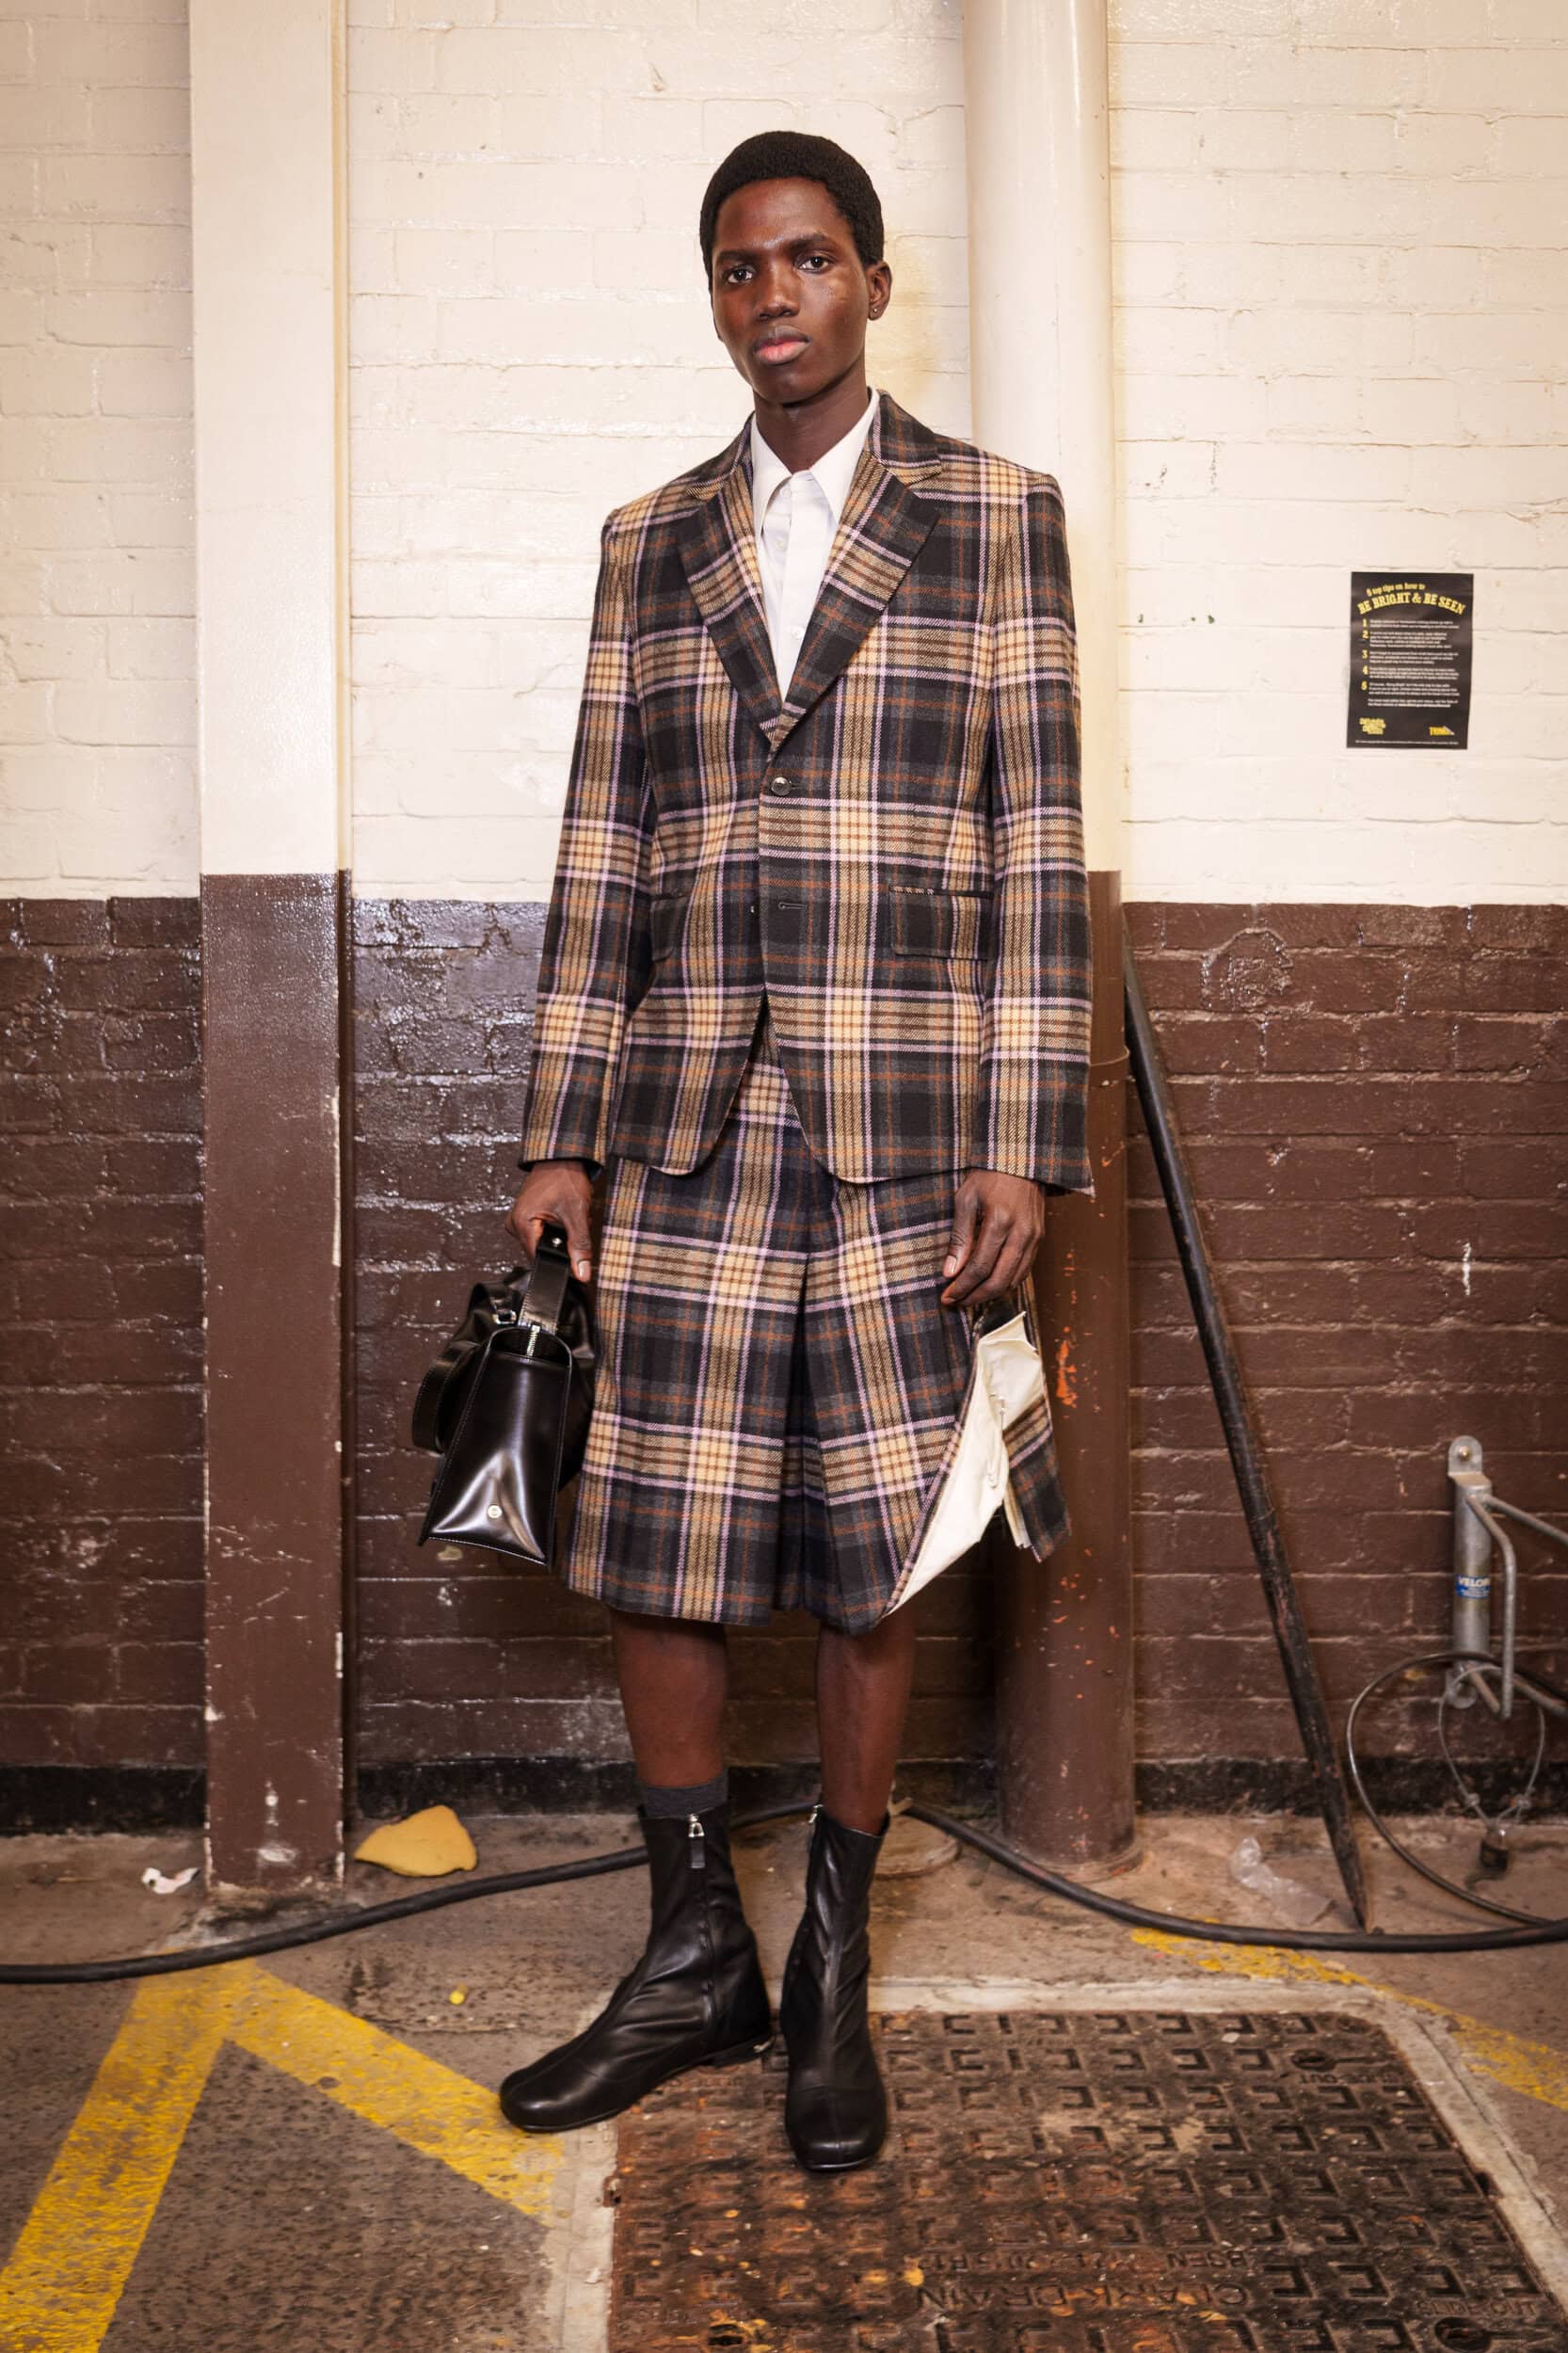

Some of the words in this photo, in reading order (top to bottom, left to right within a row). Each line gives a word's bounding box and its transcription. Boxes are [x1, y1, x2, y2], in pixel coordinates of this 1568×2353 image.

[1371, 586, 1383, 595] top
[1383, 584, 1395, 593] tips
[1404, 582, 1418, 590] how
[1357, 600, 1372, 615] BE
[1371, 592, 1411, 609] BRIGHT
[1412, 593, 1421, 603] &
[1423, 593, 1438, 605] BE
[1438, 597, 1465, 615] SEEN
[1363, 619, 1368, 628] 1
[1362, 630, 1369, 639] 2
[1362, 649, 1368, 659] 3
[1362, 664, 1368, 675] 4
[1361, 680, 1368, 691] 5
